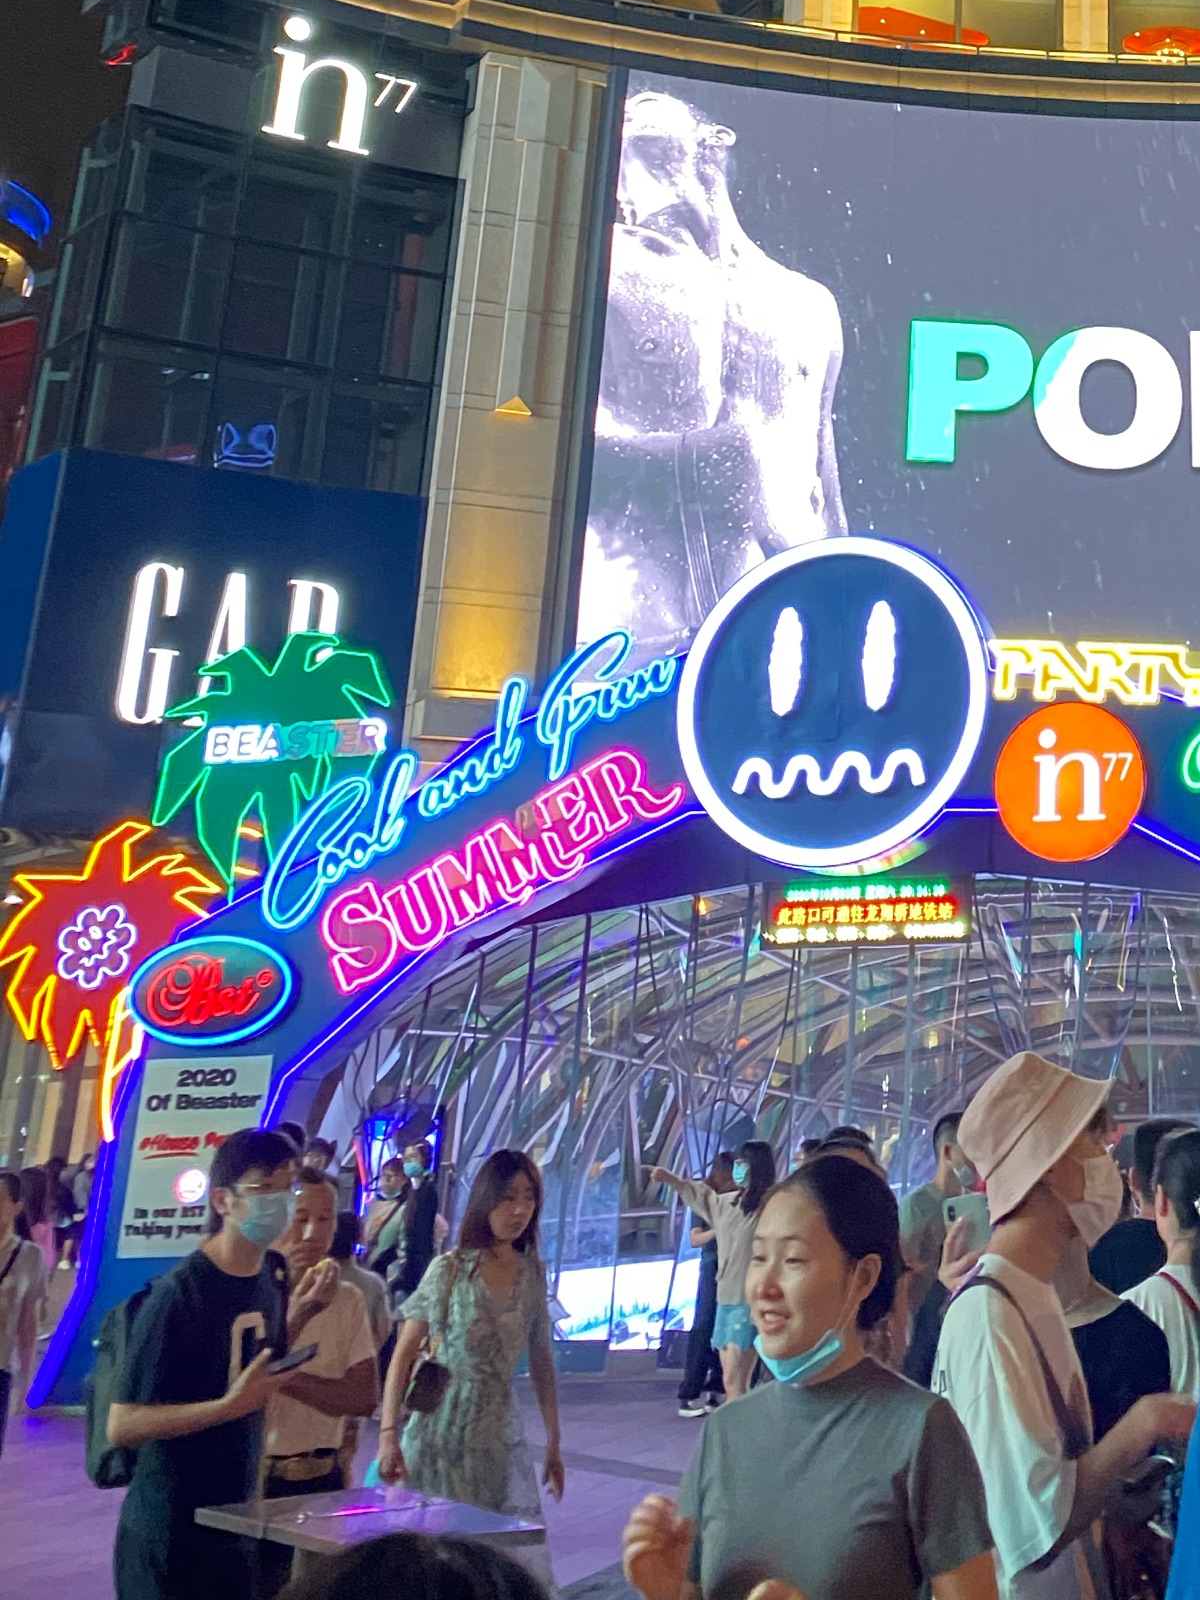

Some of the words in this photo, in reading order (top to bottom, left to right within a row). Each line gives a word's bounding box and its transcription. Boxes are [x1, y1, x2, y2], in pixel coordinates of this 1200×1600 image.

[205, 717, 387, 764] BEASTER
[262, 754, 418, 931] Cool
[418, 678, 527, 815] and
[537, 626, 678, 781] Fun
[319, 750, 684, 996] SUMMER
[177, 1068, 237, 1087] 2020
[146, 1094, 171, 1112] Of
[176, 1092, 264, 1111] Beaster
